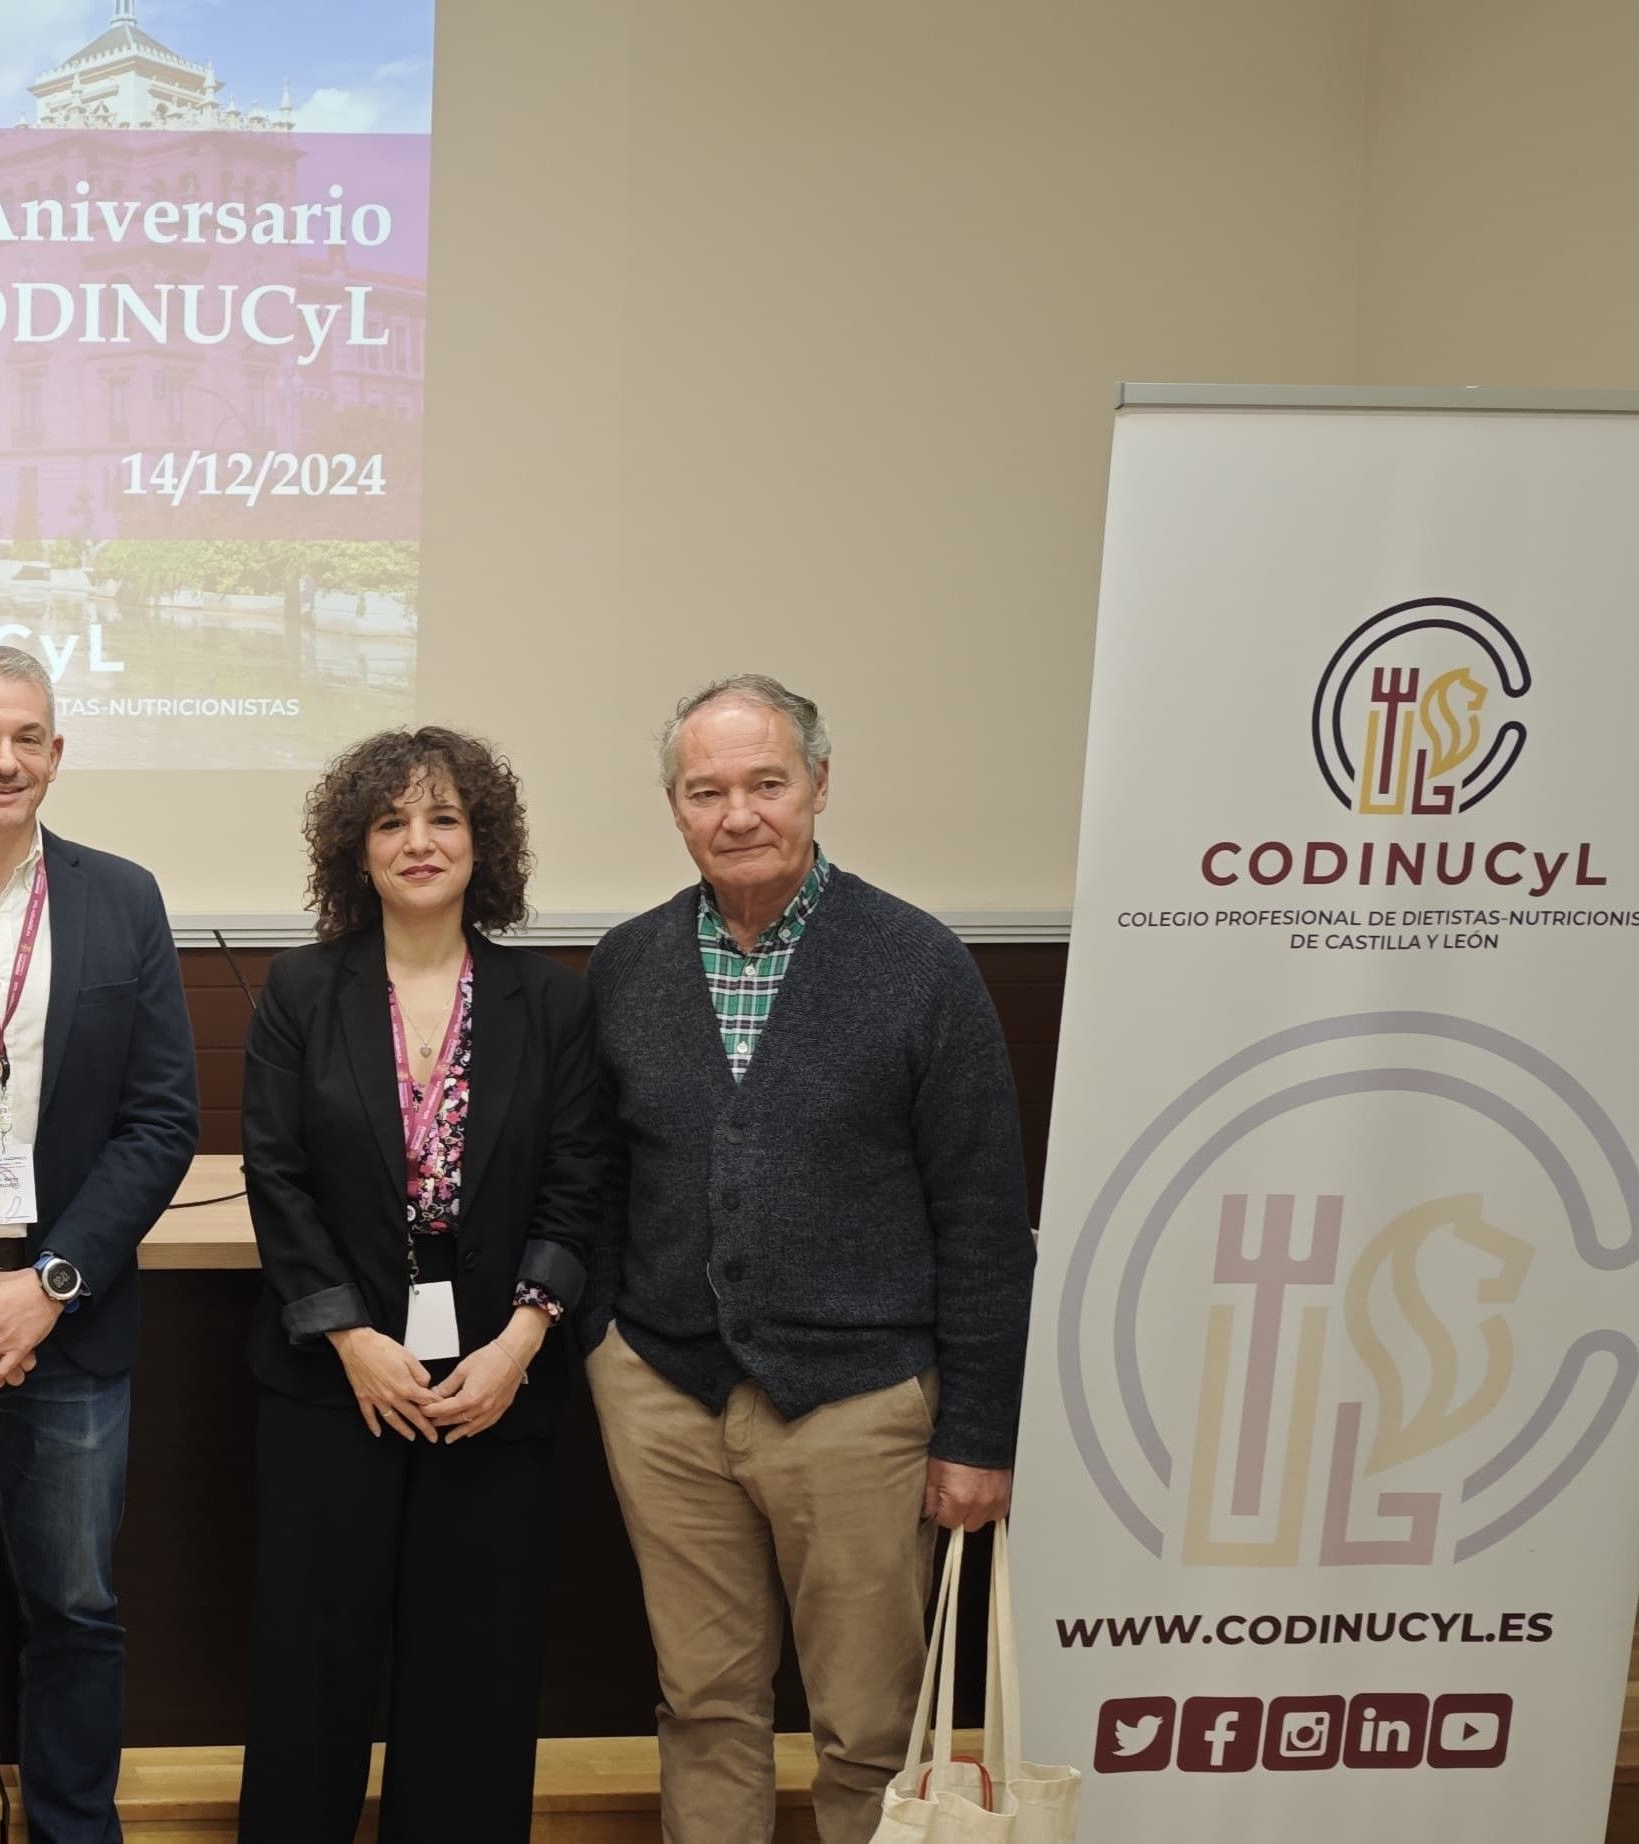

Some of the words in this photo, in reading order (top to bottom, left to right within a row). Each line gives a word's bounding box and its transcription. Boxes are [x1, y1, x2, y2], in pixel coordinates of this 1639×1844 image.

[121, 449, 387, 507] 14/12/2024
[55, 697, 301, 716] TAS-NUTRICIONISTAS
[1200, 840, 1608, 898] CODINUCyL
[1117, 910, 1210, 928] COLEGIO
[1214, 909, 1363, 926] PROFESIONAL
[1367, 910, 1397, 926] DE
[1289, 933, 1320, 949] DE
[1324, 933, 1422, 950] CASTILLA
[1426, 933, 1440, 949] Y
[1442, 929, 1499, 949] LEÓN
[1055, 1611, 1554, 1648] WWW.CODINUCYL.ES
